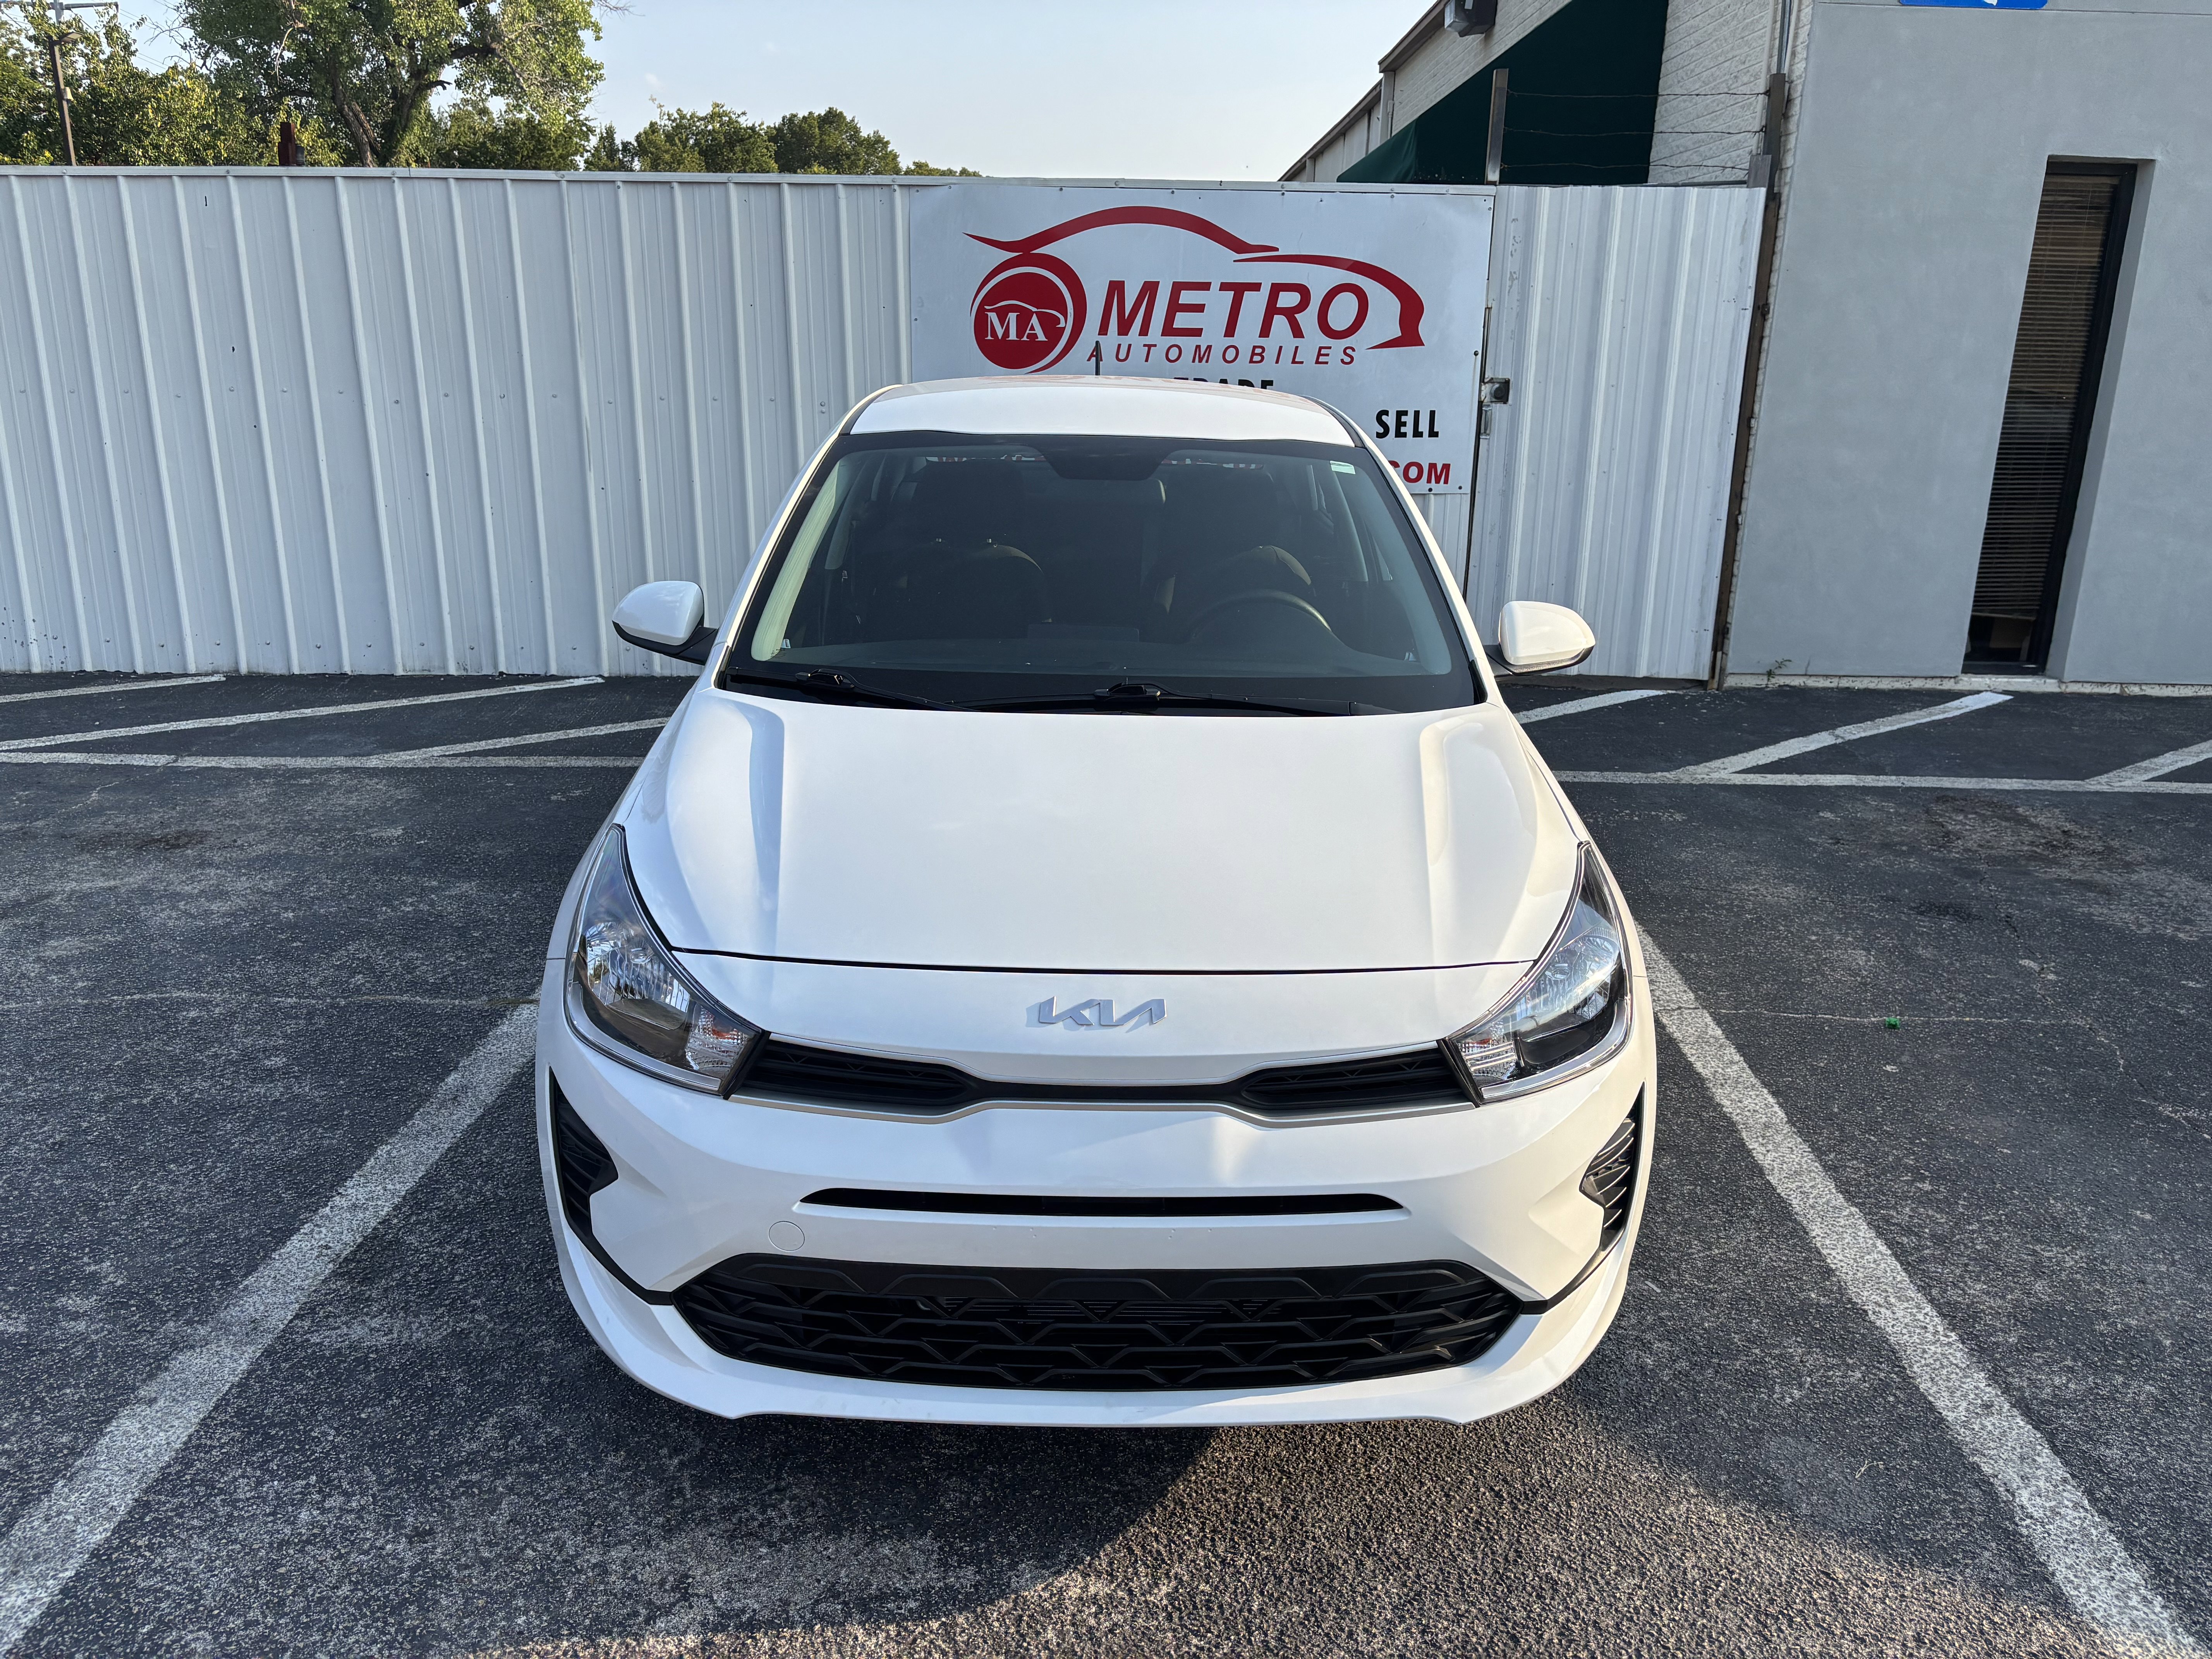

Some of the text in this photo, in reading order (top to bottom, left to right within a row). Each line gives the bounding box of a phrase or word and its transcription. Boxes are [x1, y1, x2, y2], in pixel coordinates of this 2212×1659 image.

[1097, 280, 1369, 340] METRO
[984, 312, 1048, 341] MA
[1086, 343, 1356, 365] AUTOMOBILES
[1376, 409, 1439, 439] SELL
[1039, 996, 1167, 1026] KIA
